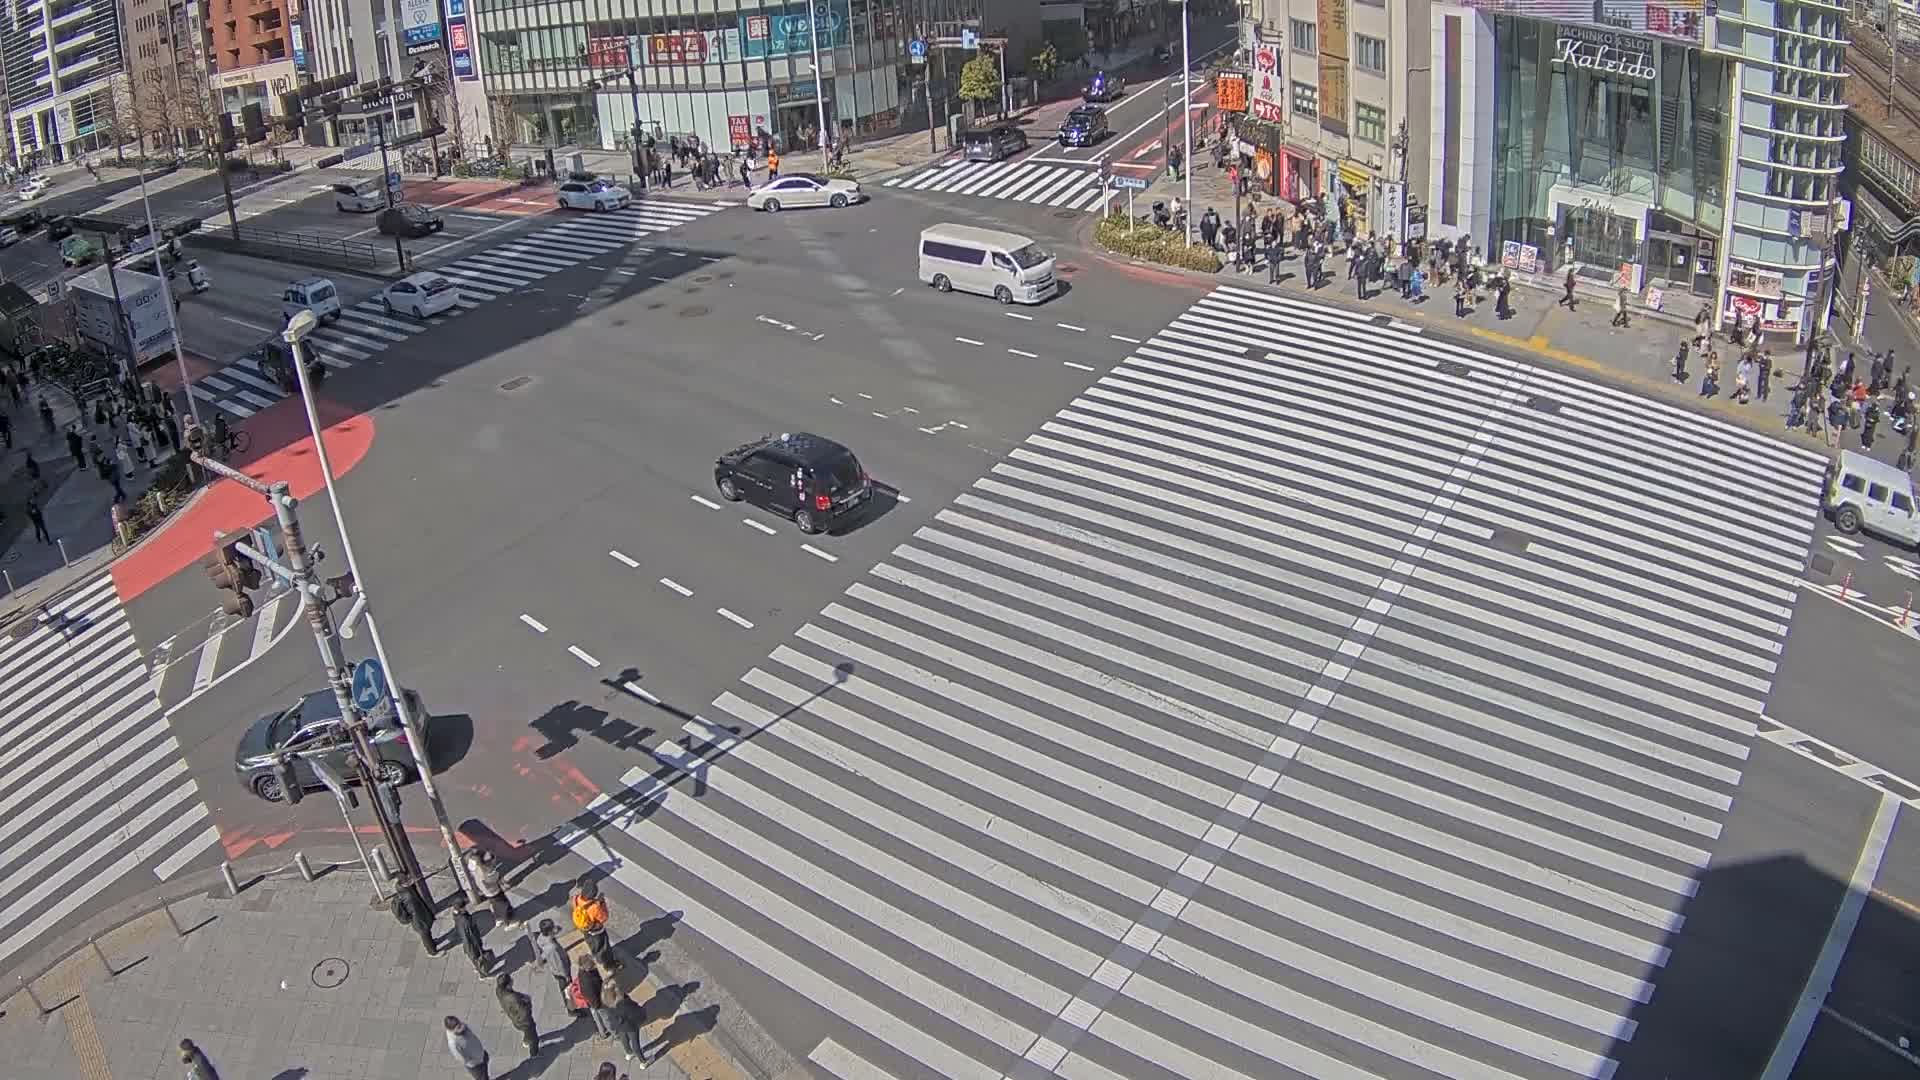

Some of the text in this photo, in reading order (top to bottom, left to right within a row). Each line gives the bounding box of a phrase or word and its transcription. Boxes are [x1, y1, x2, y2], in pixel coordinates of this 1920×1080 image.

[1557, 25, 1612, 44] PACHINKO
[1625, 38, 1650, 52] SLOT
[1551, 38, 1656, 80] Kaleido
[730, 117, 746, 125] TAX
